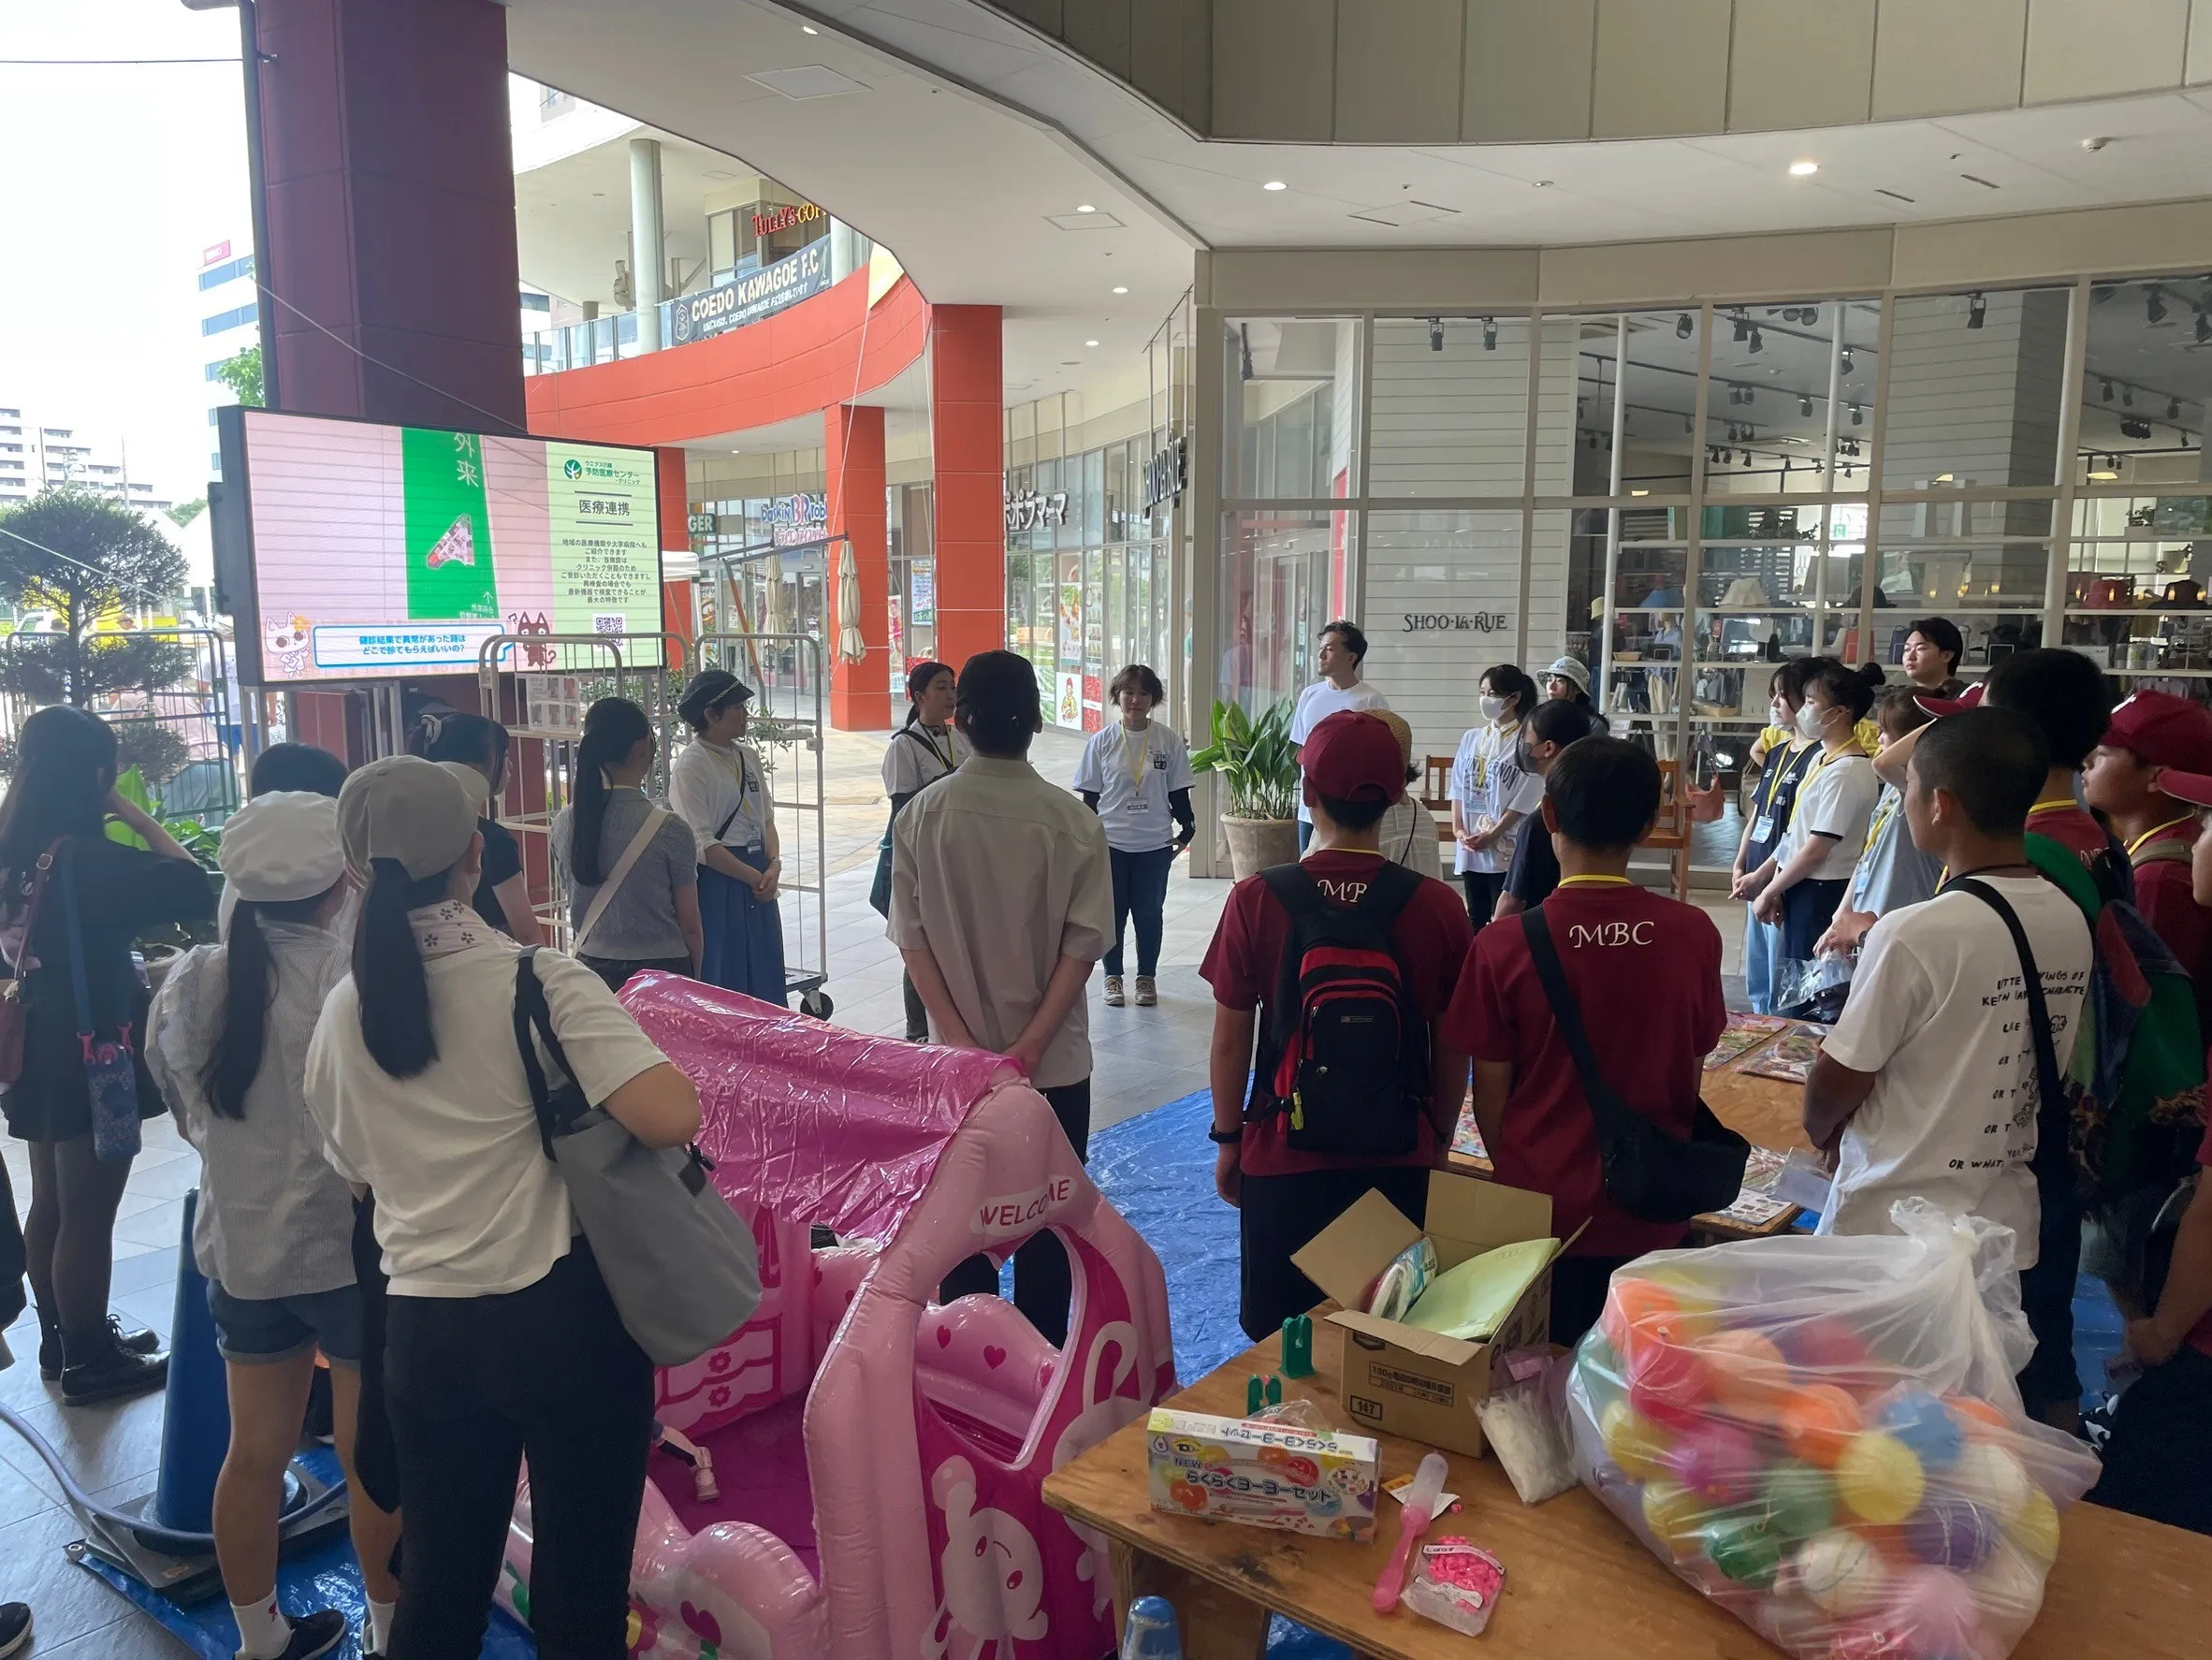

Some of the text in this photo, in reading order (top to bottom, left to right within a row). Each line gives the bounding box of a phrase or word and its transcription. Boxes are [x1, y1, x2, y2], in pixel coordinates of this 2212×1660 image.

[691, 287, 735, 322] COEDO
[737, 258, 798, 306] KAWAGOE
[454, 432, 478, 488] 外来
[585, 467, 640, 478] 予防医療センター
[579, 499, 630, 516] 医療連携
[585, 547, 627, 556] ご紹介できます
[1569, 920, 1655, 949] MBC
[1984, 1125, 1998, 1133] OR
[1948, 1159, 1964, 1170] OR
[1358, 1401, 1375, 1415] 147
[1174, 1457, 1201, 1468] NEW
[1186, 1470, 1332, 1503] らくらくヨーヨーセット
